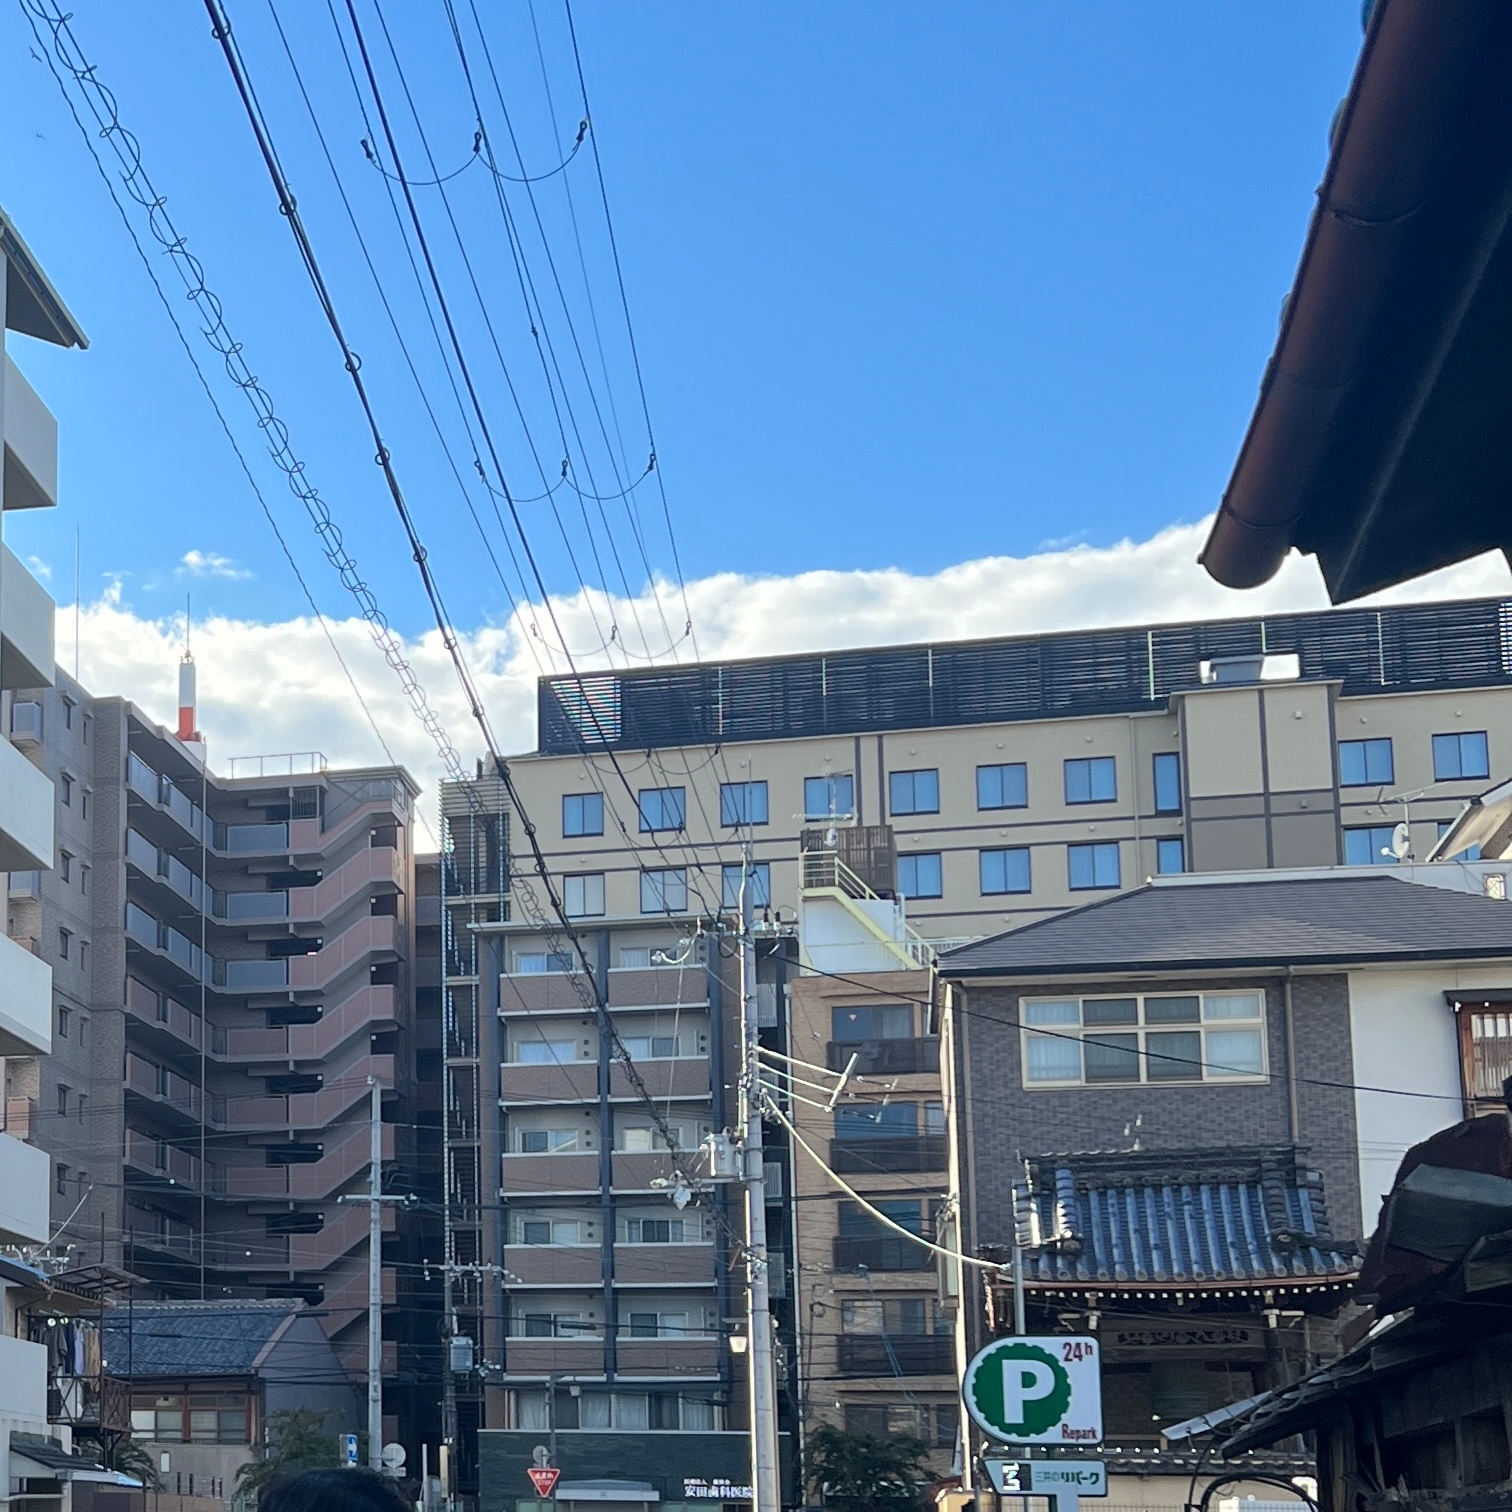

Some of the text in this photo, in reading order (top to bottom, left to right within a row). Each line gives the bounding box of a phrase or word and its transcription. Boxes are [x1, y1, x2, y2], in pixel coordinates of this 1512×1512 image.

[1001, 1359, 1056, 1425] P
[1061, 1423, 1099, 1442] Repark
[1035, 1470, 1100, 1486] 三井のリパーク
